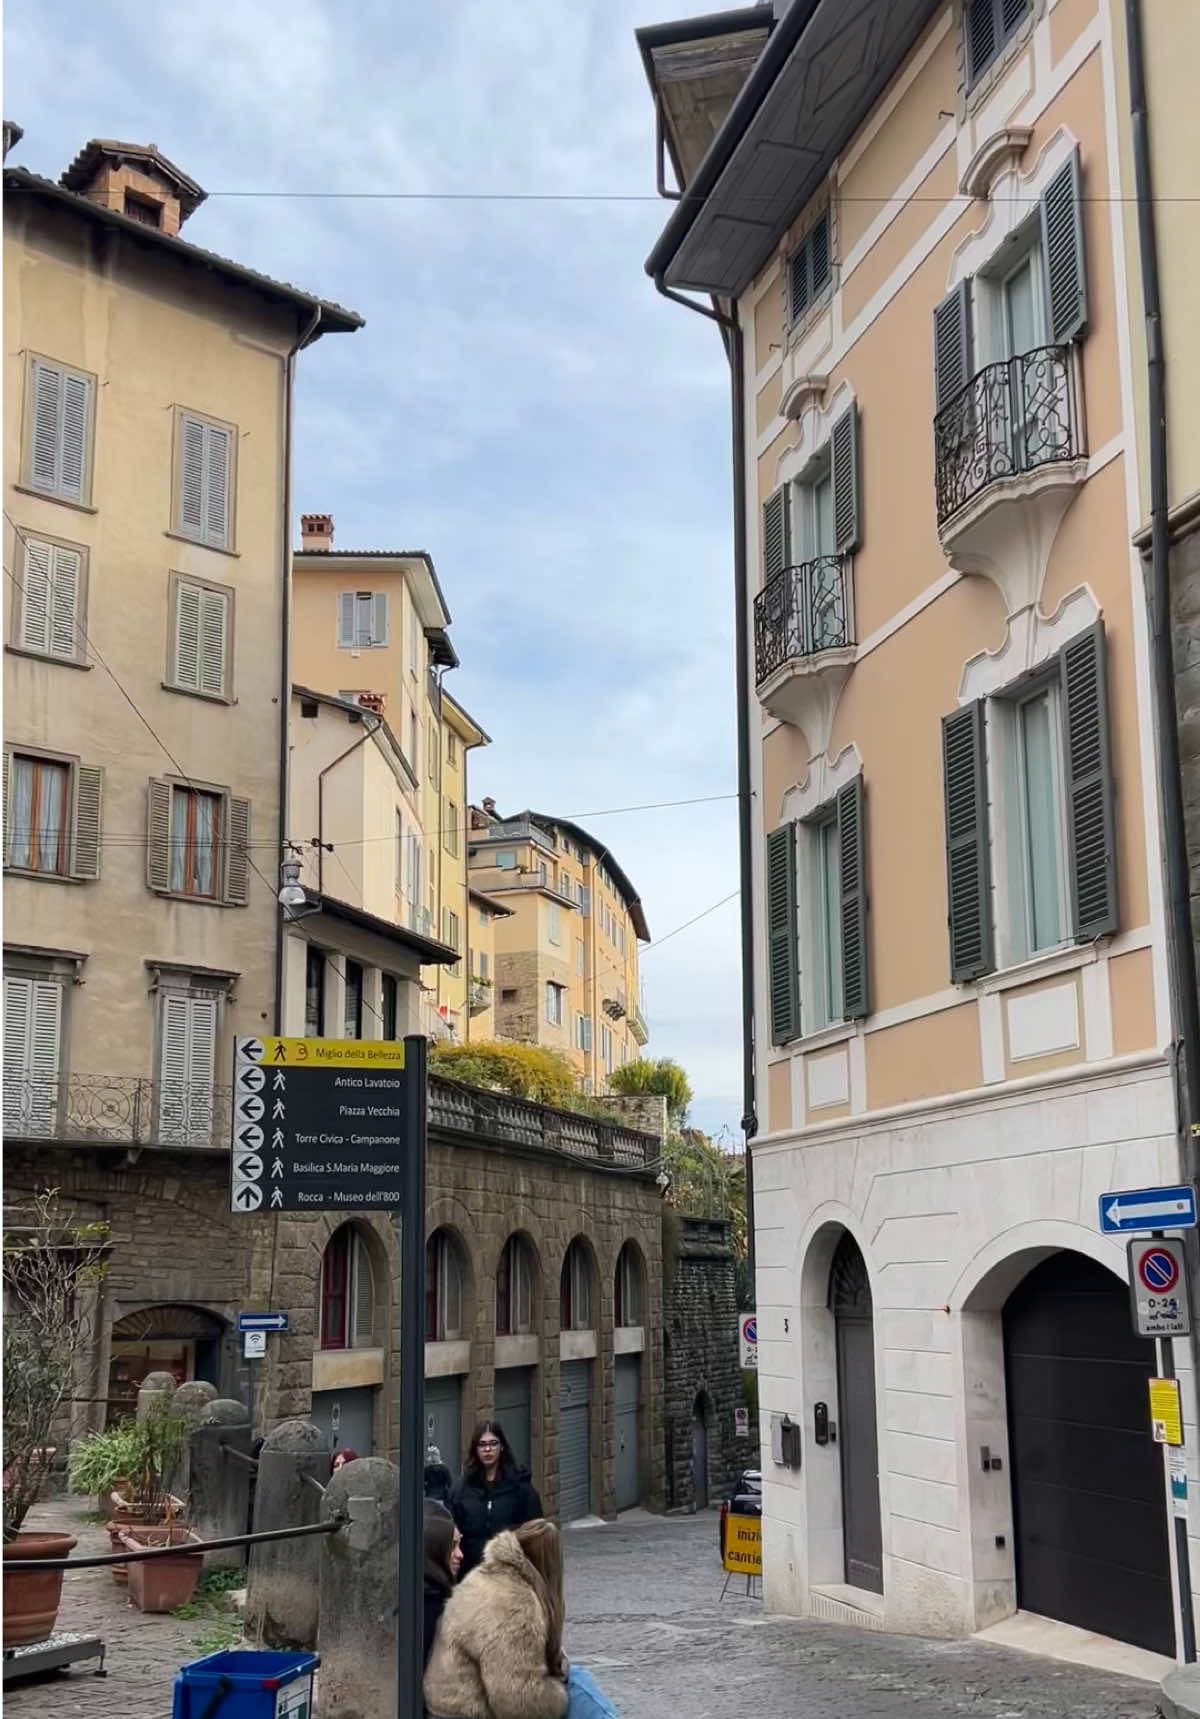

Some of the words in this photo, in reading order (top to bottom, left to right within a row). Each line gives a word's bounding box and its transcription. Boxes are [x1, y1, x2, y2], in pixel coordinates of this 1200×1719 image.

[316, 1047, 343, 1060] Miglio
[344, 1049, 365, 1059] della
[367, 1049, 401, 1060] Bellezza
[334, 1076, 363, 1088] Antico
[364, 1078, 401, 1089] Lavatoio
[339, 1105, 366, 1116] Piazza
[367, 1105, 400, 1117] Vecchia
[295, 1133, 318, 1144] Torre
[319, 1134, 344, 1144] Civica
[350, 1134, 401, 1146] Campanone
[293, 1162, 325, 1173] Basilica
[326, 1162, 359, 1173] S.Maria
[360, 1162, 400, 1175] Maggiore
[298, 1191, 324, 1202] Rocca
[333, 1191, 364, 1202] Museo
[365, 1190, 400, 1202] dell'800
[737, 1526, 762, 1542] inizi
[728, 1551, 762, 1565] cantie
